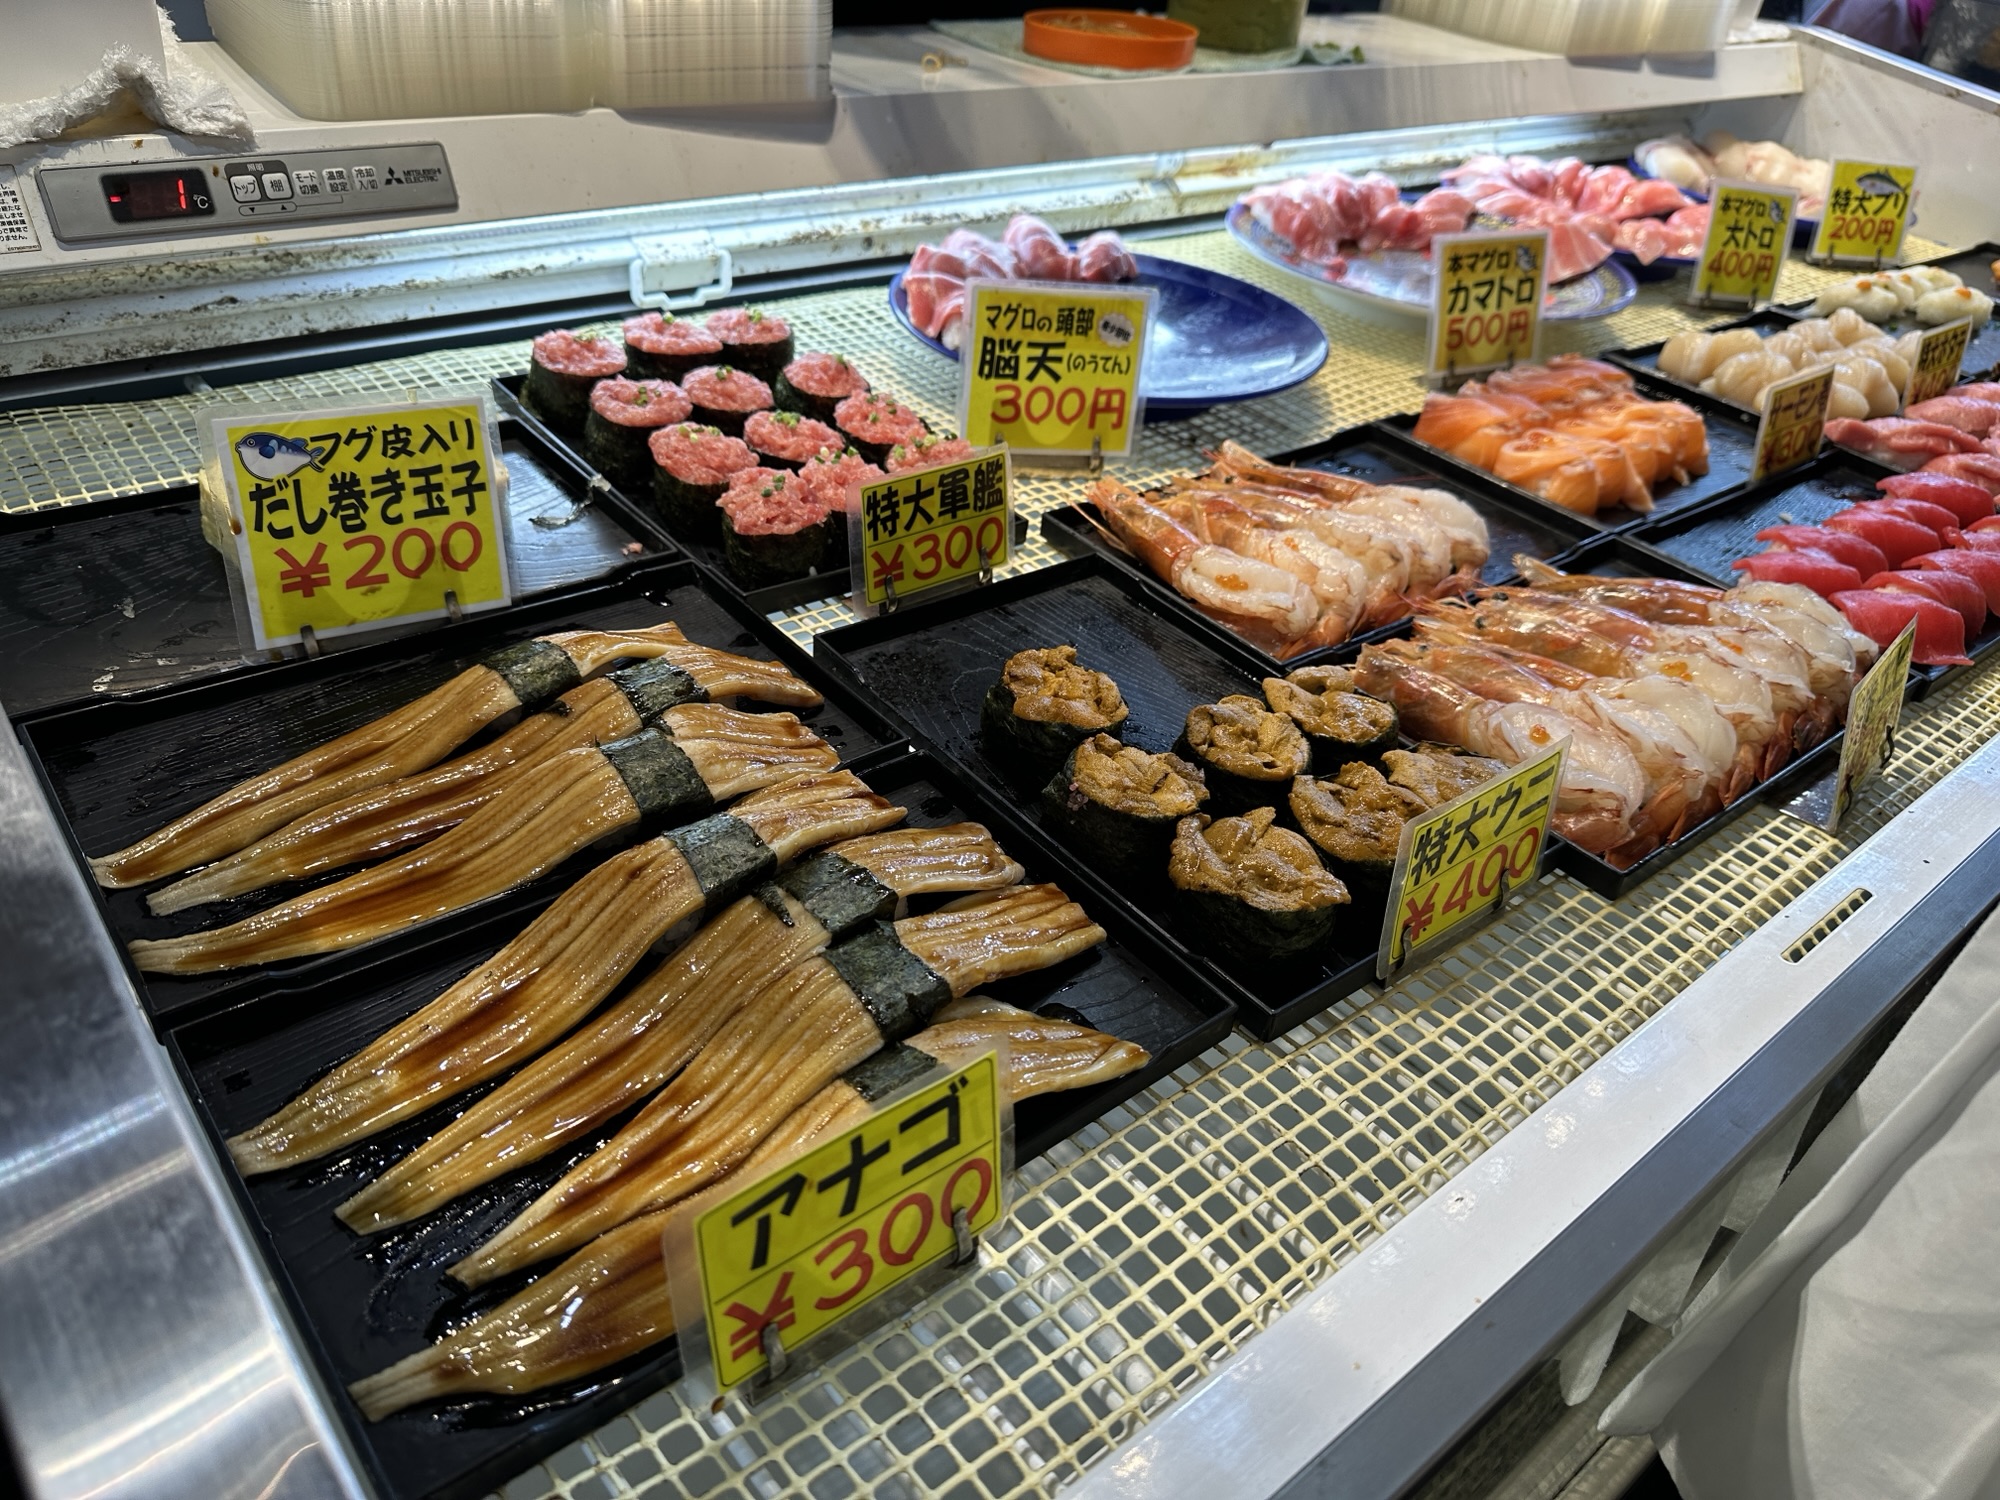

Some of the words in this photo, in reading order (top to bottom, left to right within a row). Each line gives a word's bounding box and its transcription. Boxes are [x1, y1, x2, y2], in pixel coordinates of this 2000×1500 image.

[233, 180, 256, 195] トップ
[269, 179, 285, 192] 棚
[295, 172, 317, 183] モード
[325, 170, 346, 181] 温度
[329, 182, 350, 193] 設定
[354, 168, 375, 178] 冷却
[403, 168, 442, 177] MITSUBISHI
[405, 176, 439, 184] ELECTRIC
[299, 184, 320, 195] 切換
[1720, 194, 1768, 218] 本マグロ
[1722, 218, 1775, 250] 大トロ
[1829, 216, 1895, 245] 200円
[1447, 248, 1510, 275] 本マグロ
[1708, 250, 1775, 283] 400円
[1447, 275, 1535, 315] カマトロ
[986, 303, 1095, 338] マグロの頭部
[1446, 308, 1529, 350] 500円
[991, 384, 1126, 431] 300円
[310, 418, 475, 466] フグ皮入り
[249, 460, 487, 540] だし巻き玉子
[866, 458, 1003, 542] 特大軍艦
[274, 521, 483, 598] ¥200
[871, 517, 1004, 590] ¥300
[1411, 765, 1555, 887] 特大ウニ
[1402, 827, 1539, 941] ¥400
[730, 1075, 969, 1271] アナゴ
[723, 1157, 993, 1363] ¥300
